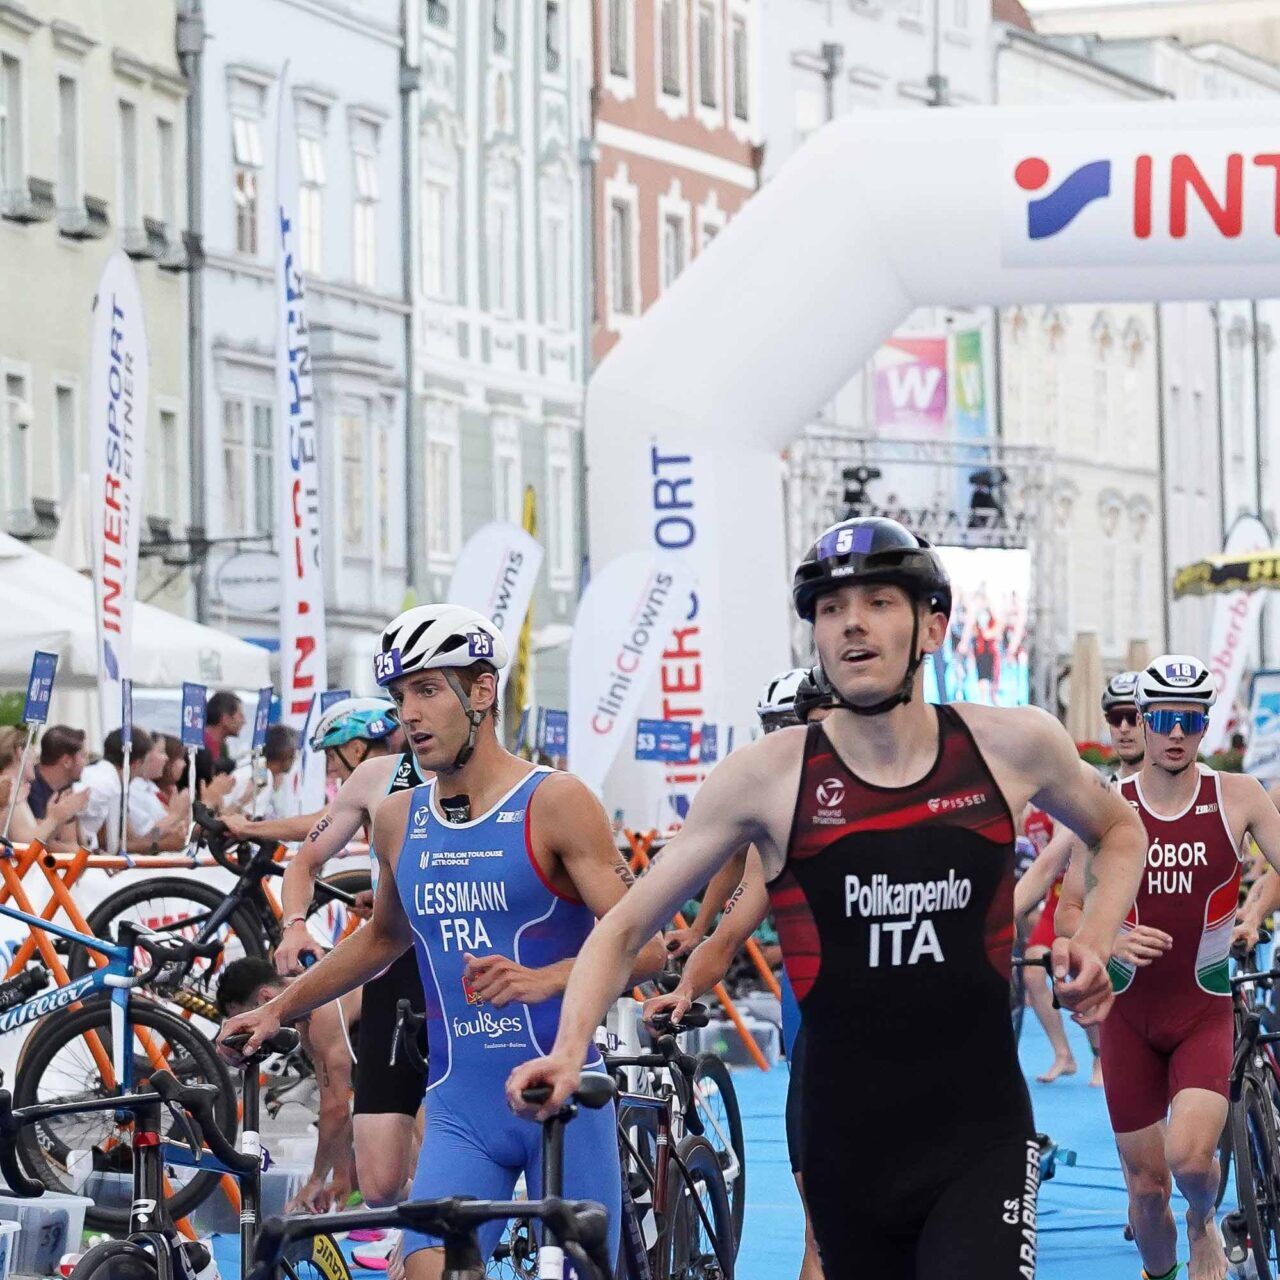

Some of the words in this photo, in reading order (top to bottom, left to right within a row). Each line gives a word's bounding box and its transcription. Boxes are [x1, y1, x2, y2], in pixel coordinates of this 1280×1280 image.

[886, 366, 941, 409] W
[103, 294, 125, 635] INTERSPORT
[836, 529, 854, 553] 5
[473, 634, 489, 655] 25
[591, 572, 673, 736] CliniClowns
[376, 654, 394, 679] 25
[1172, 664, 1191, 677] 18
[941, 793, 986, 809] PISSEI
[468, 850, 504, 858] TOULOUSE
[1144, 838, 1208, 868] ÓBOR
[845, 868, 972, 925] Polikarpenko
[1147, 871, 1193, 895] HUN
[414, 881, 509, 916] LESSMANN
[724, 885, 746, 917] 26
[440, 917, 493, 953] FRA
[869, 919, 946, 968] ITA
[453, 1010, 522, 1038] foul&es
[1002, 1197, 1020, 1225] C.S.
